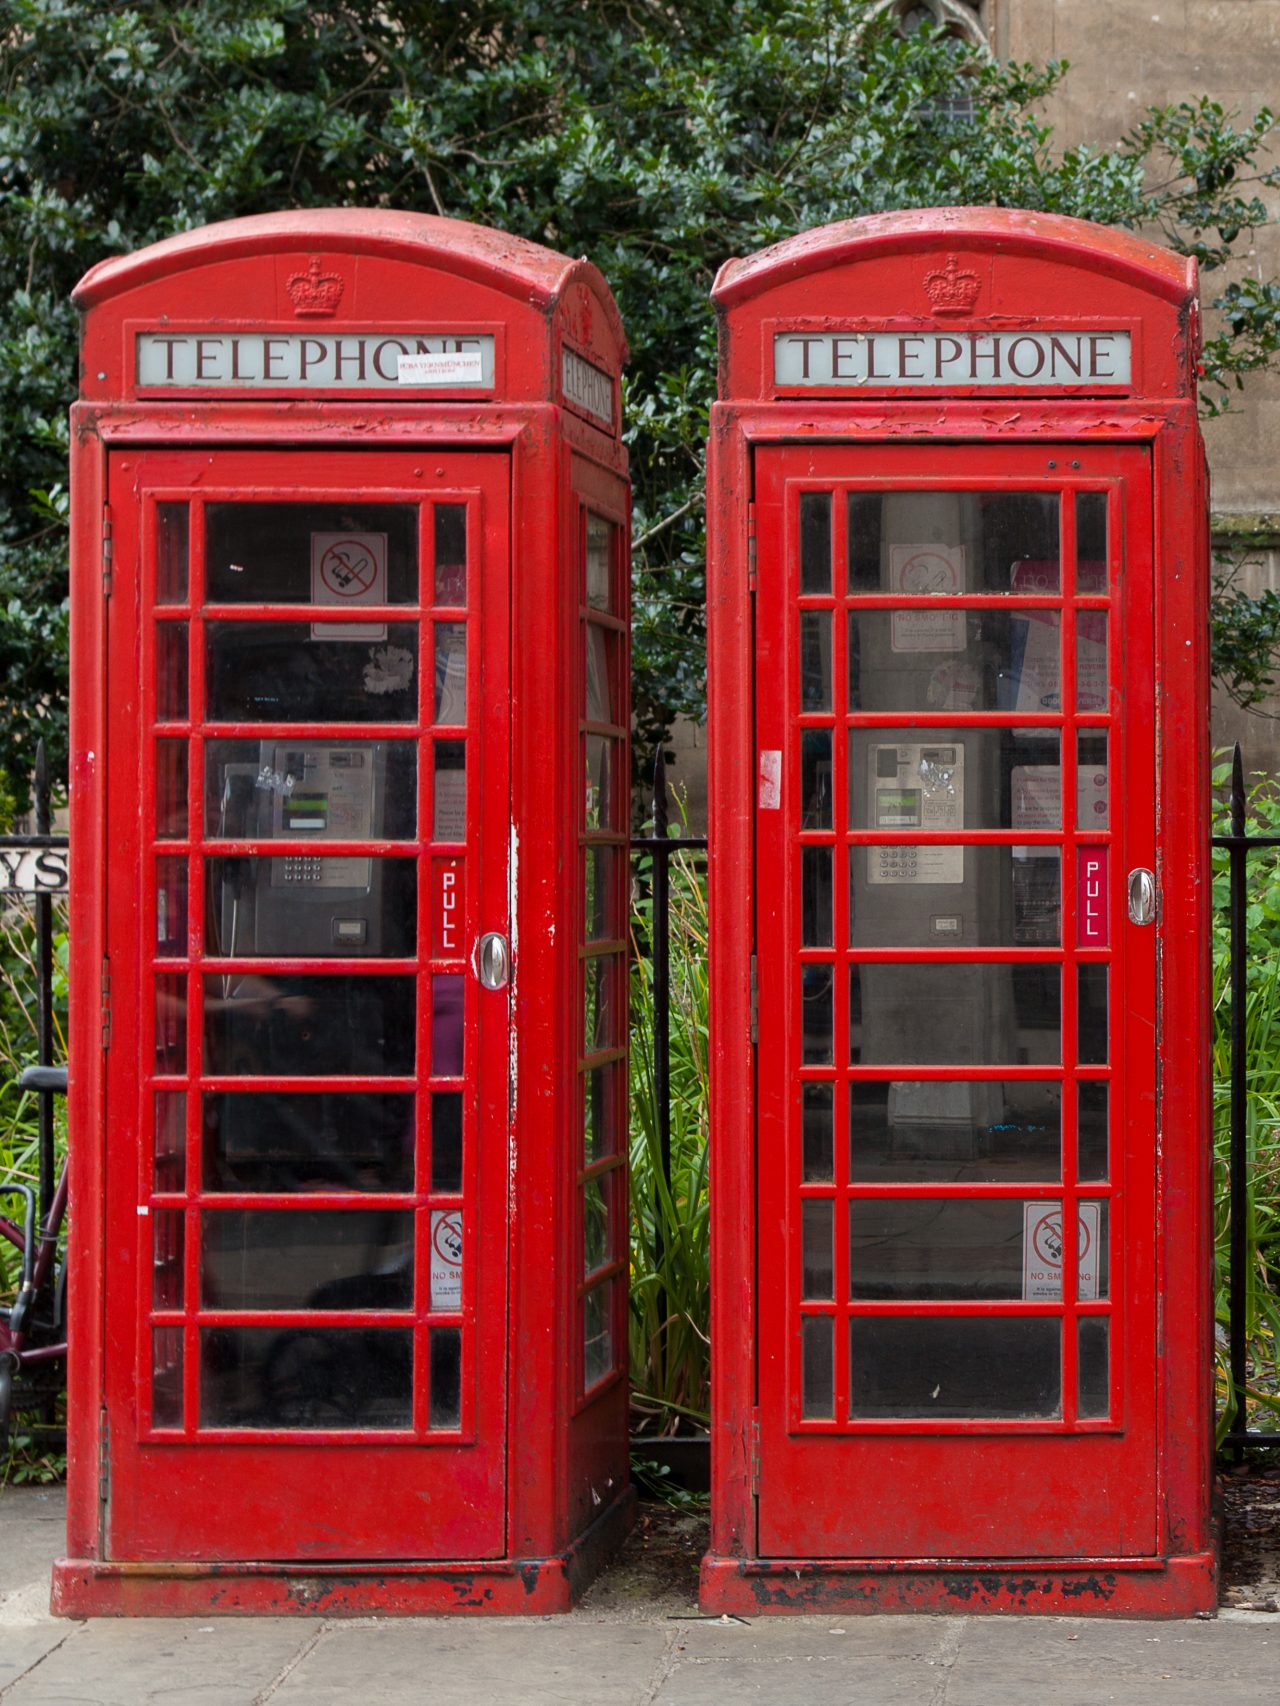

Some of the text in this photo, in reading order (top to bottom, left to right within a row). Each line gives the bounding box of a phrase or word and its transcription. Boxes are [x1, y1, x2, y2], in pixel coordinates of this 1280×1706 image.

[787, 336, 1115, 379] TELEPHONE
[443, 873, 455, 948] PULL
[1087, 861, 1099, 935] PULL
[432, 1271, 446, 1280] NO
[1030, 1272, 1091, 1281] NO SMNG
